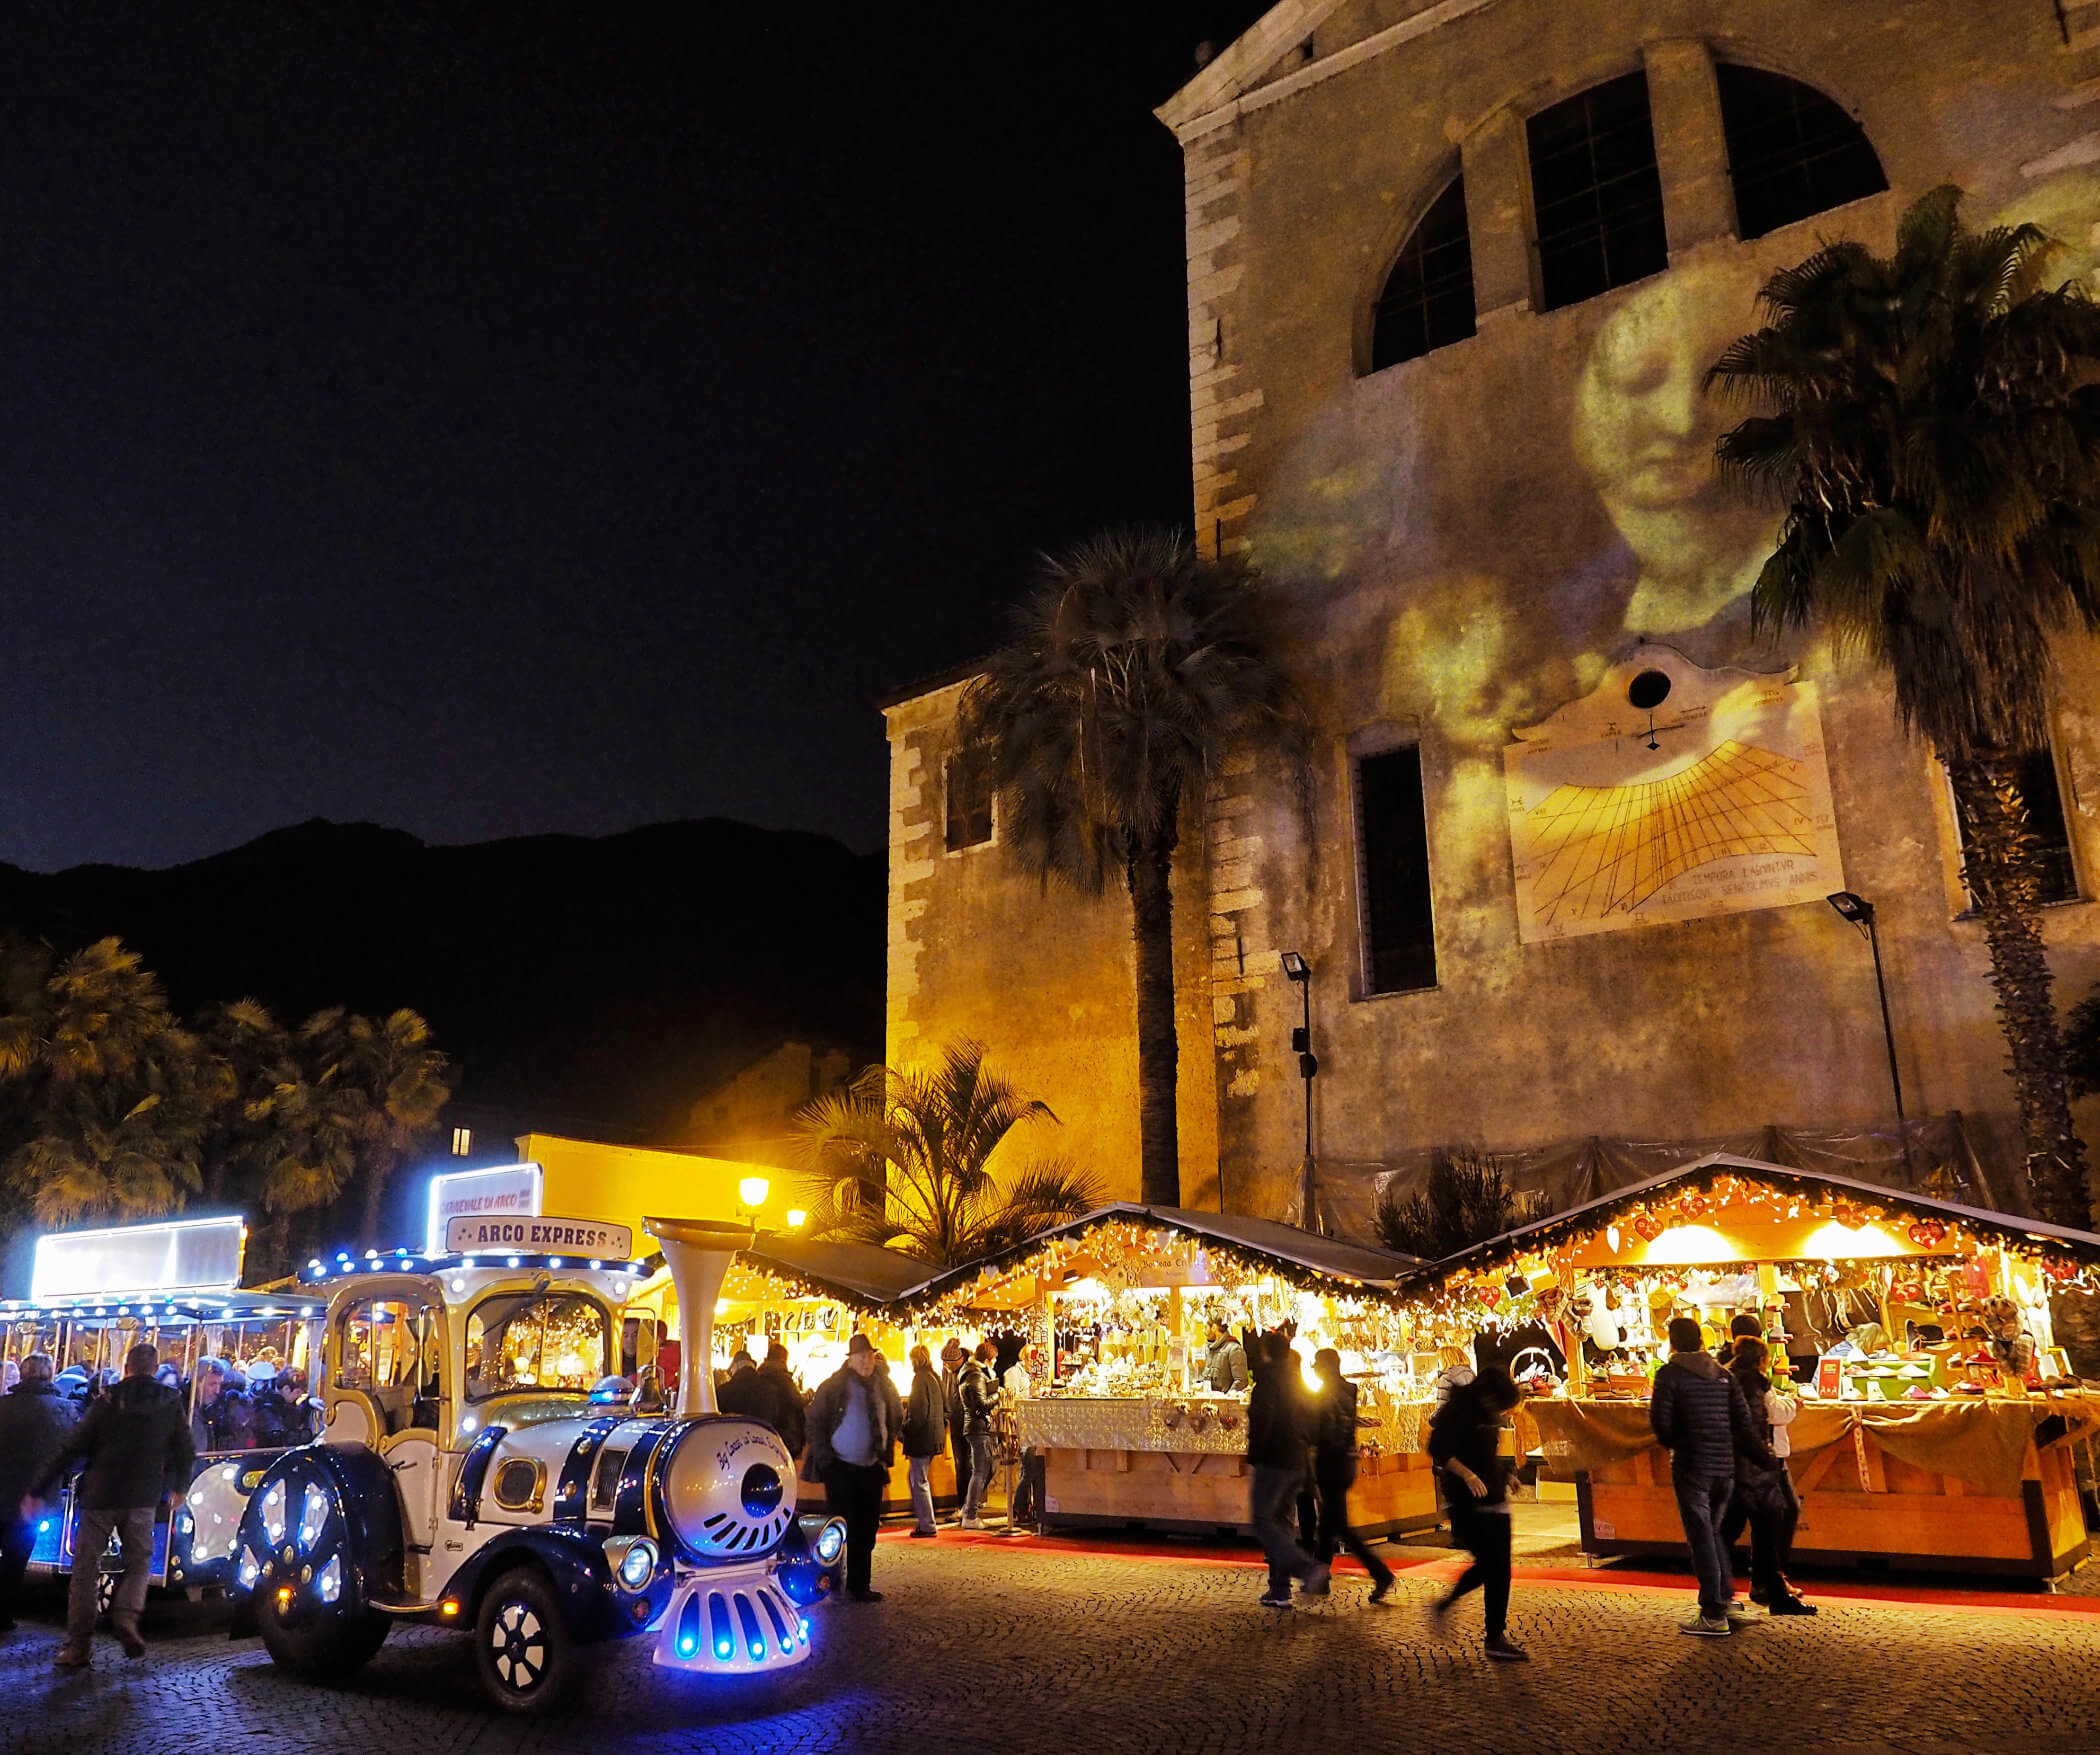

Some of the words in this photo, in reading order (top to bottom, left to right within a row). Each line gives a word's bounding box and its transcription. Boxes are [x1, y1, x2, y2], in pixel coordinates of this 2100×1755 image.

[495, 1193, 518, 1209] ARCO
[478, 1224, 524, 1243] ARCO
[531, 1226, 607, 1248] EXPRESS
